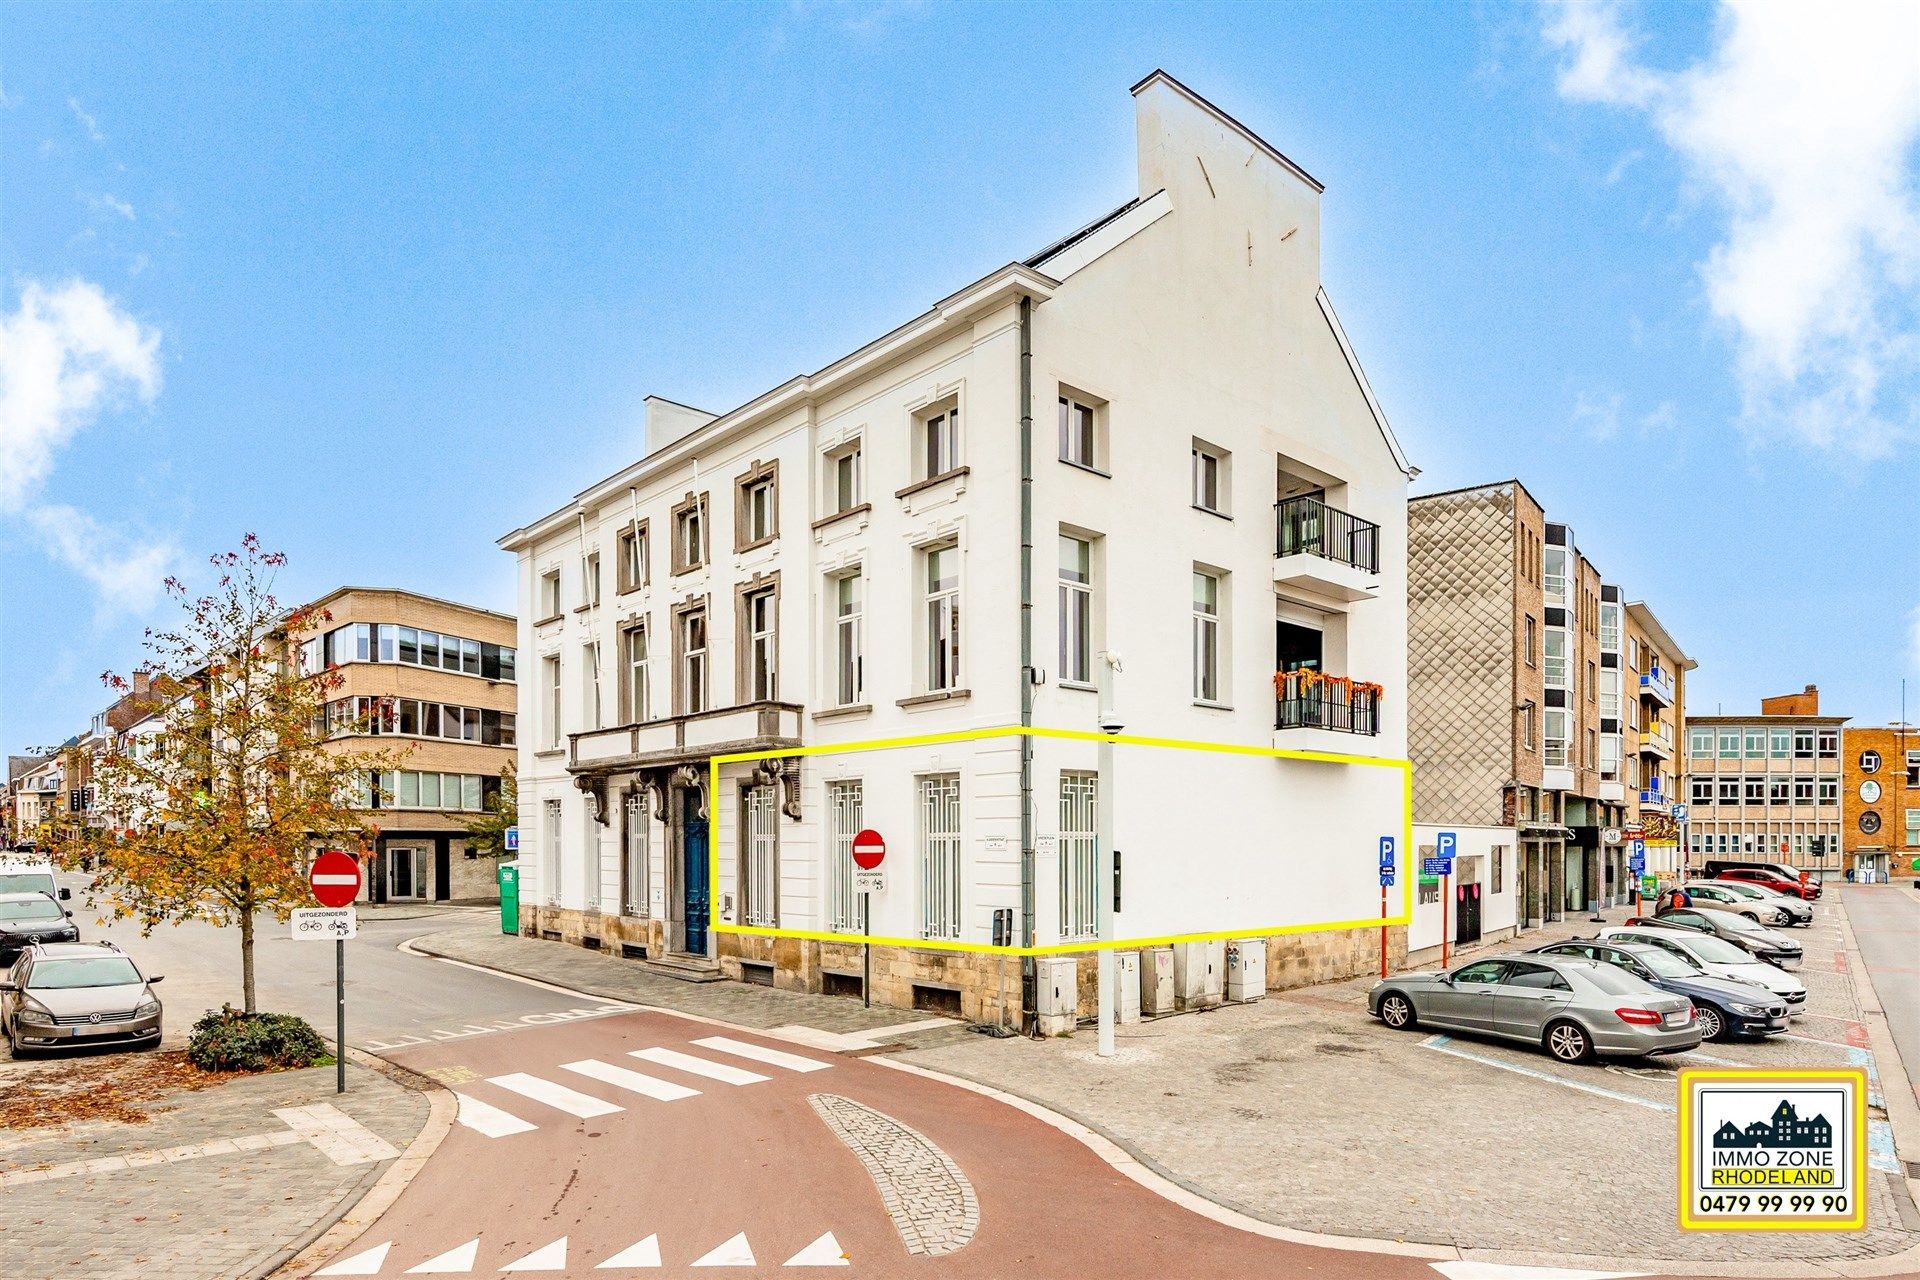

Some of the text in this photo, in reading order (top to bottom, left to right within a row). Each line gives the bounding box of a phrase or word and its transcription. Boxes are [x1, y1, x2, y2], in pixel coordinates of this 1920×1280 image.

[1382, 840, 1393, 862] P
[1440, 836, 1454, 854] P
[1635, 842, 1643, 856] P
